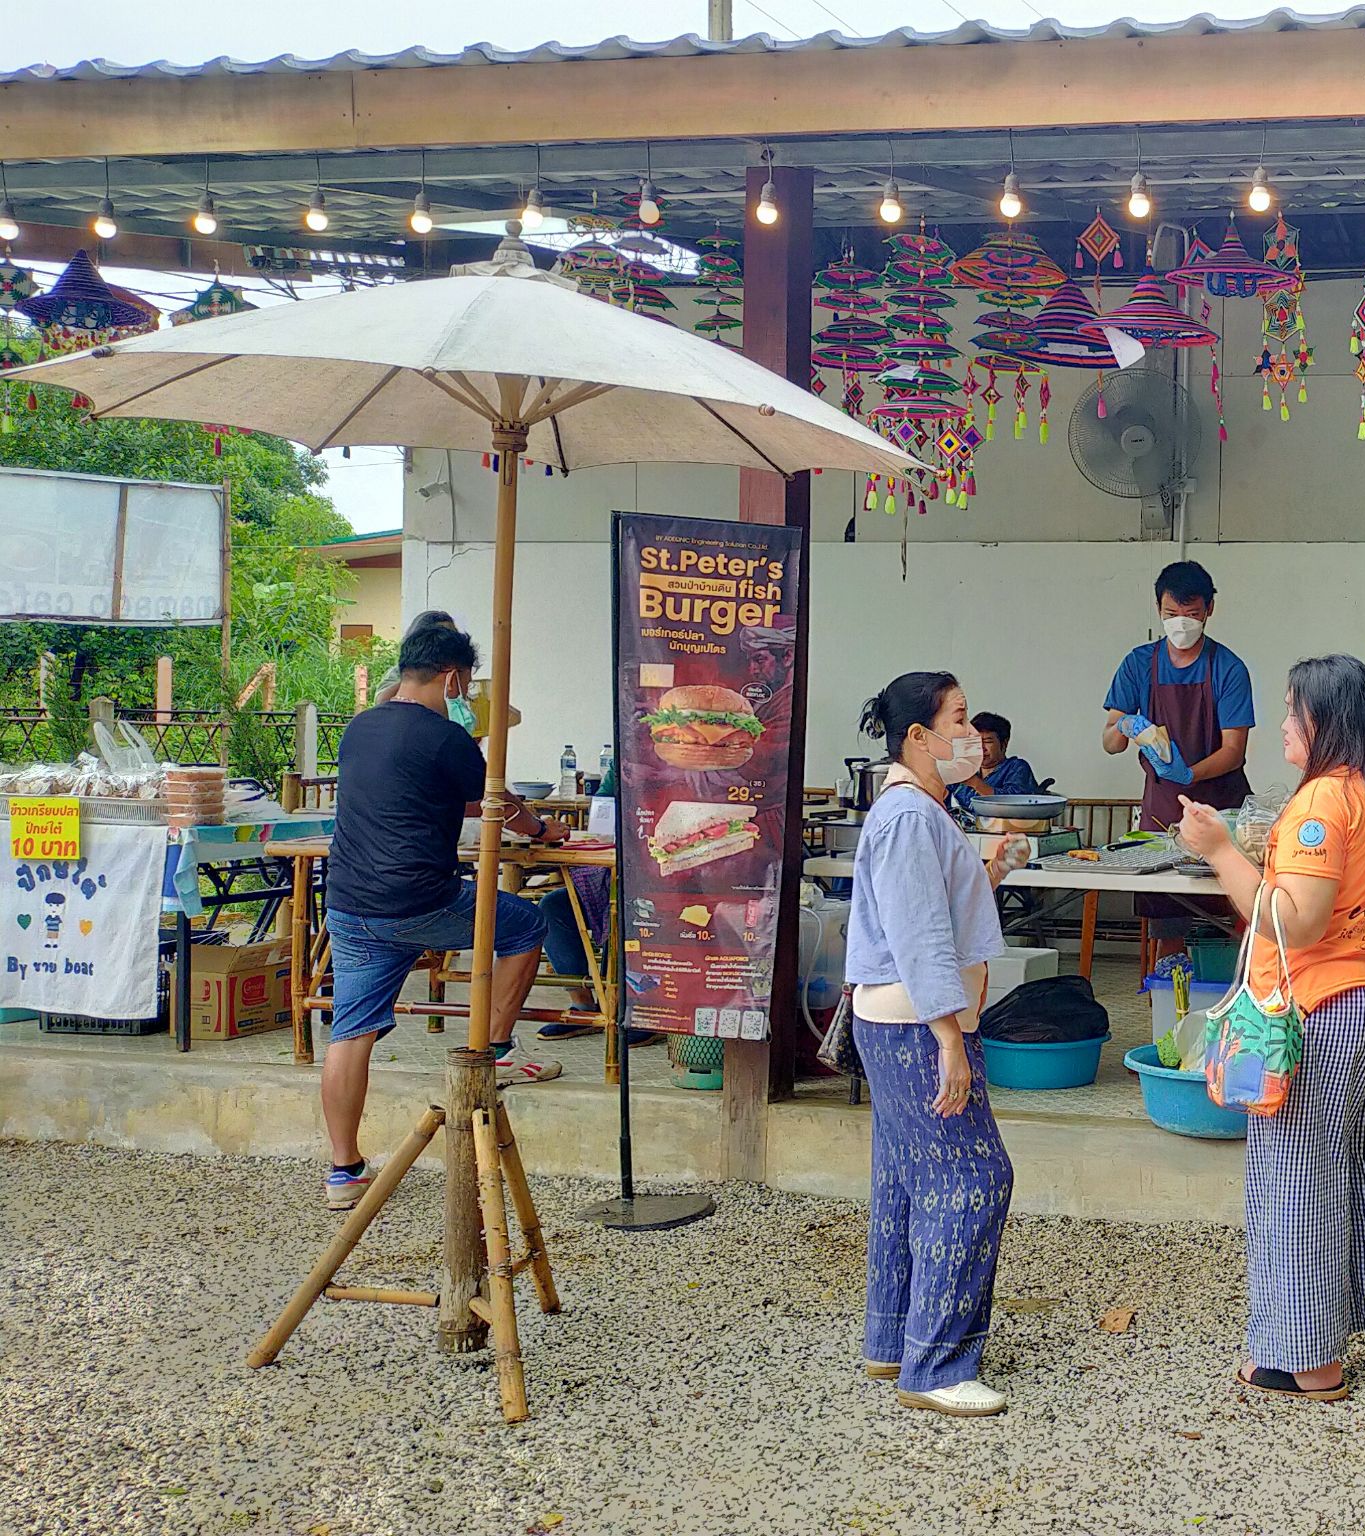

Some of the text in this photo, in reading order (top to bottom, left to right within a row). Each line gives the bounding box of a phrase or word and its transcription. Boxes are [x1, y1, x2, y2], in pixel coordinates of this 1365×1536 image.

[640, 546, 784, 580] St.Peter's
[738, 579, 782, 600] fish
[640, 587, 781, 635] Burger
[10, 802, 79, 817] ข้าวเกรียบปลา
[25, 820, 63, 834] ปักษ์ใต้
[12, 837, 77, 857] 10 บาท
[7, 956, 28, 981] By
[64, 957, 94, 976] boat
